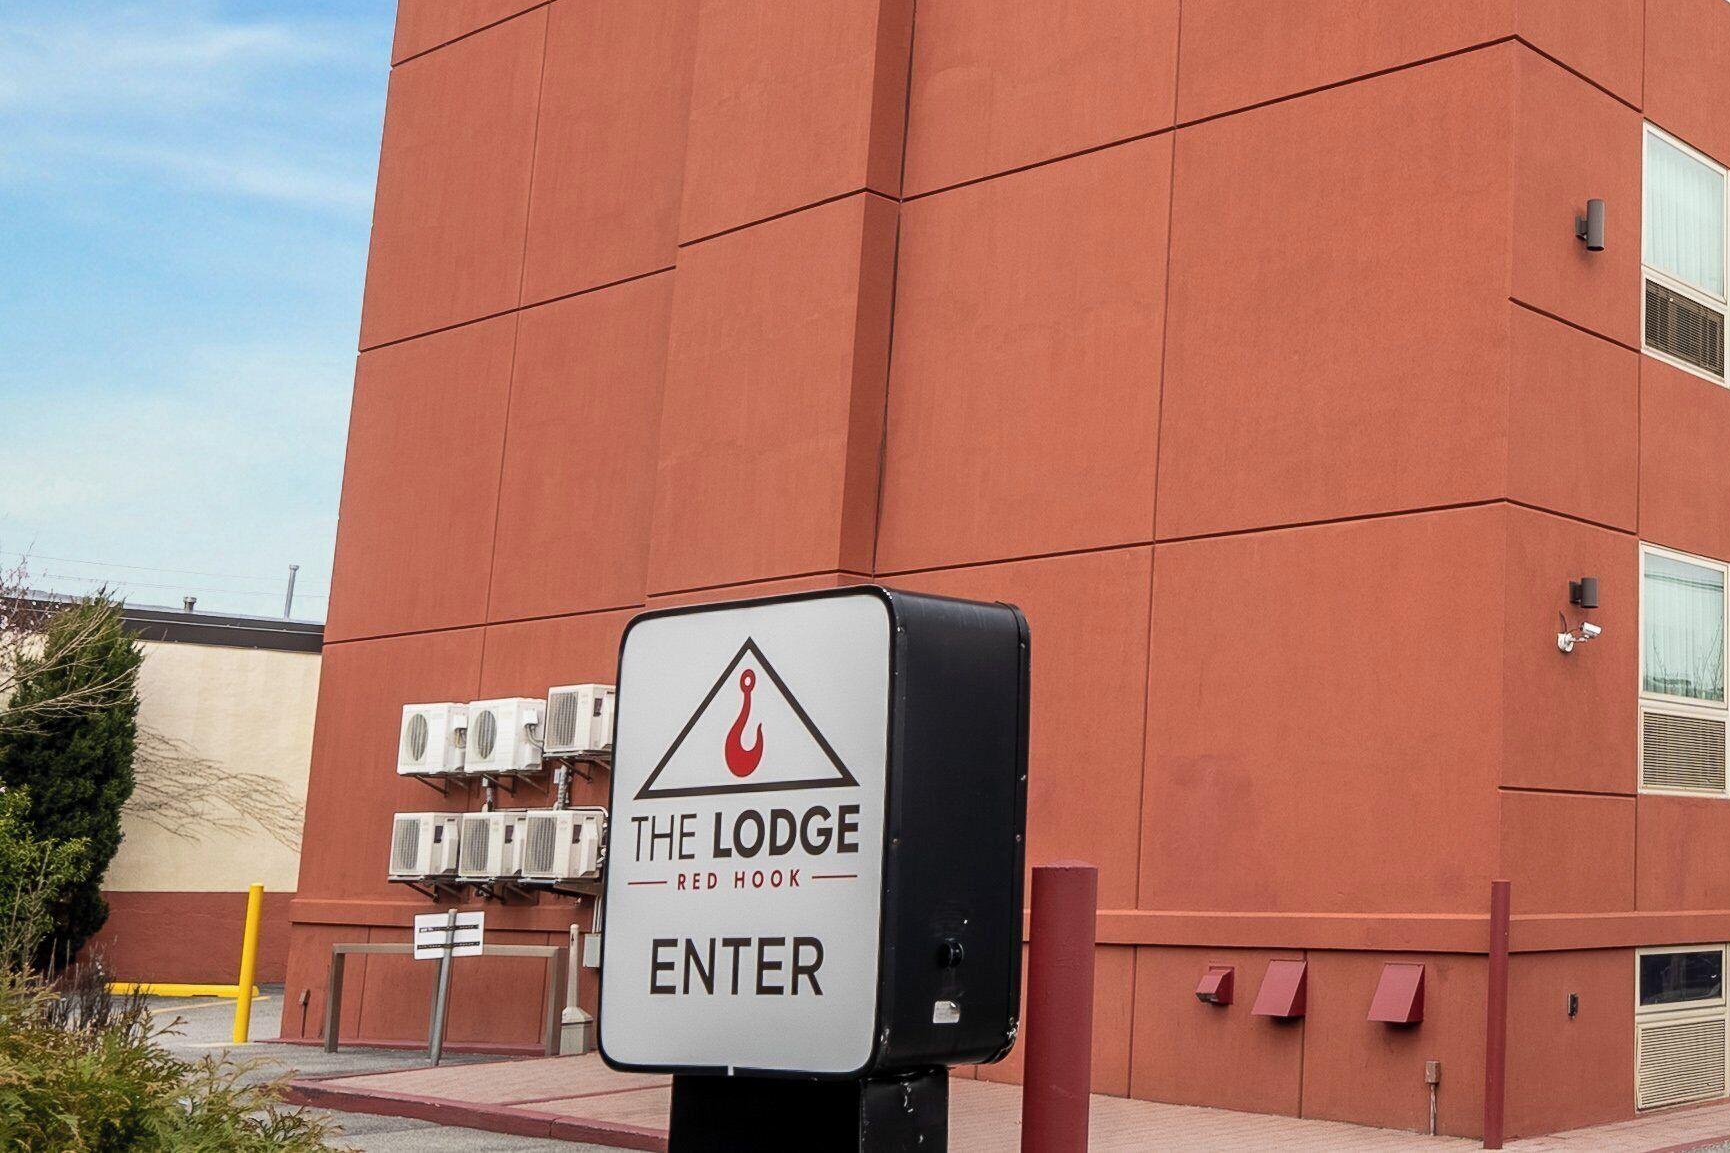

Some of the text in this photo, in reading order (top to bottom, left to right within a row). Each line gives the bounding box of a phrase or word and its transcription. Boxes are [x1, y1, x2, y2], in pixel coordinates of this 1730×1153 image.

[631, 804, 861, 861] THE LODGE
[677, 868, 801, 890] RED HOOK
[650, 937, 825, 996] ENTER
